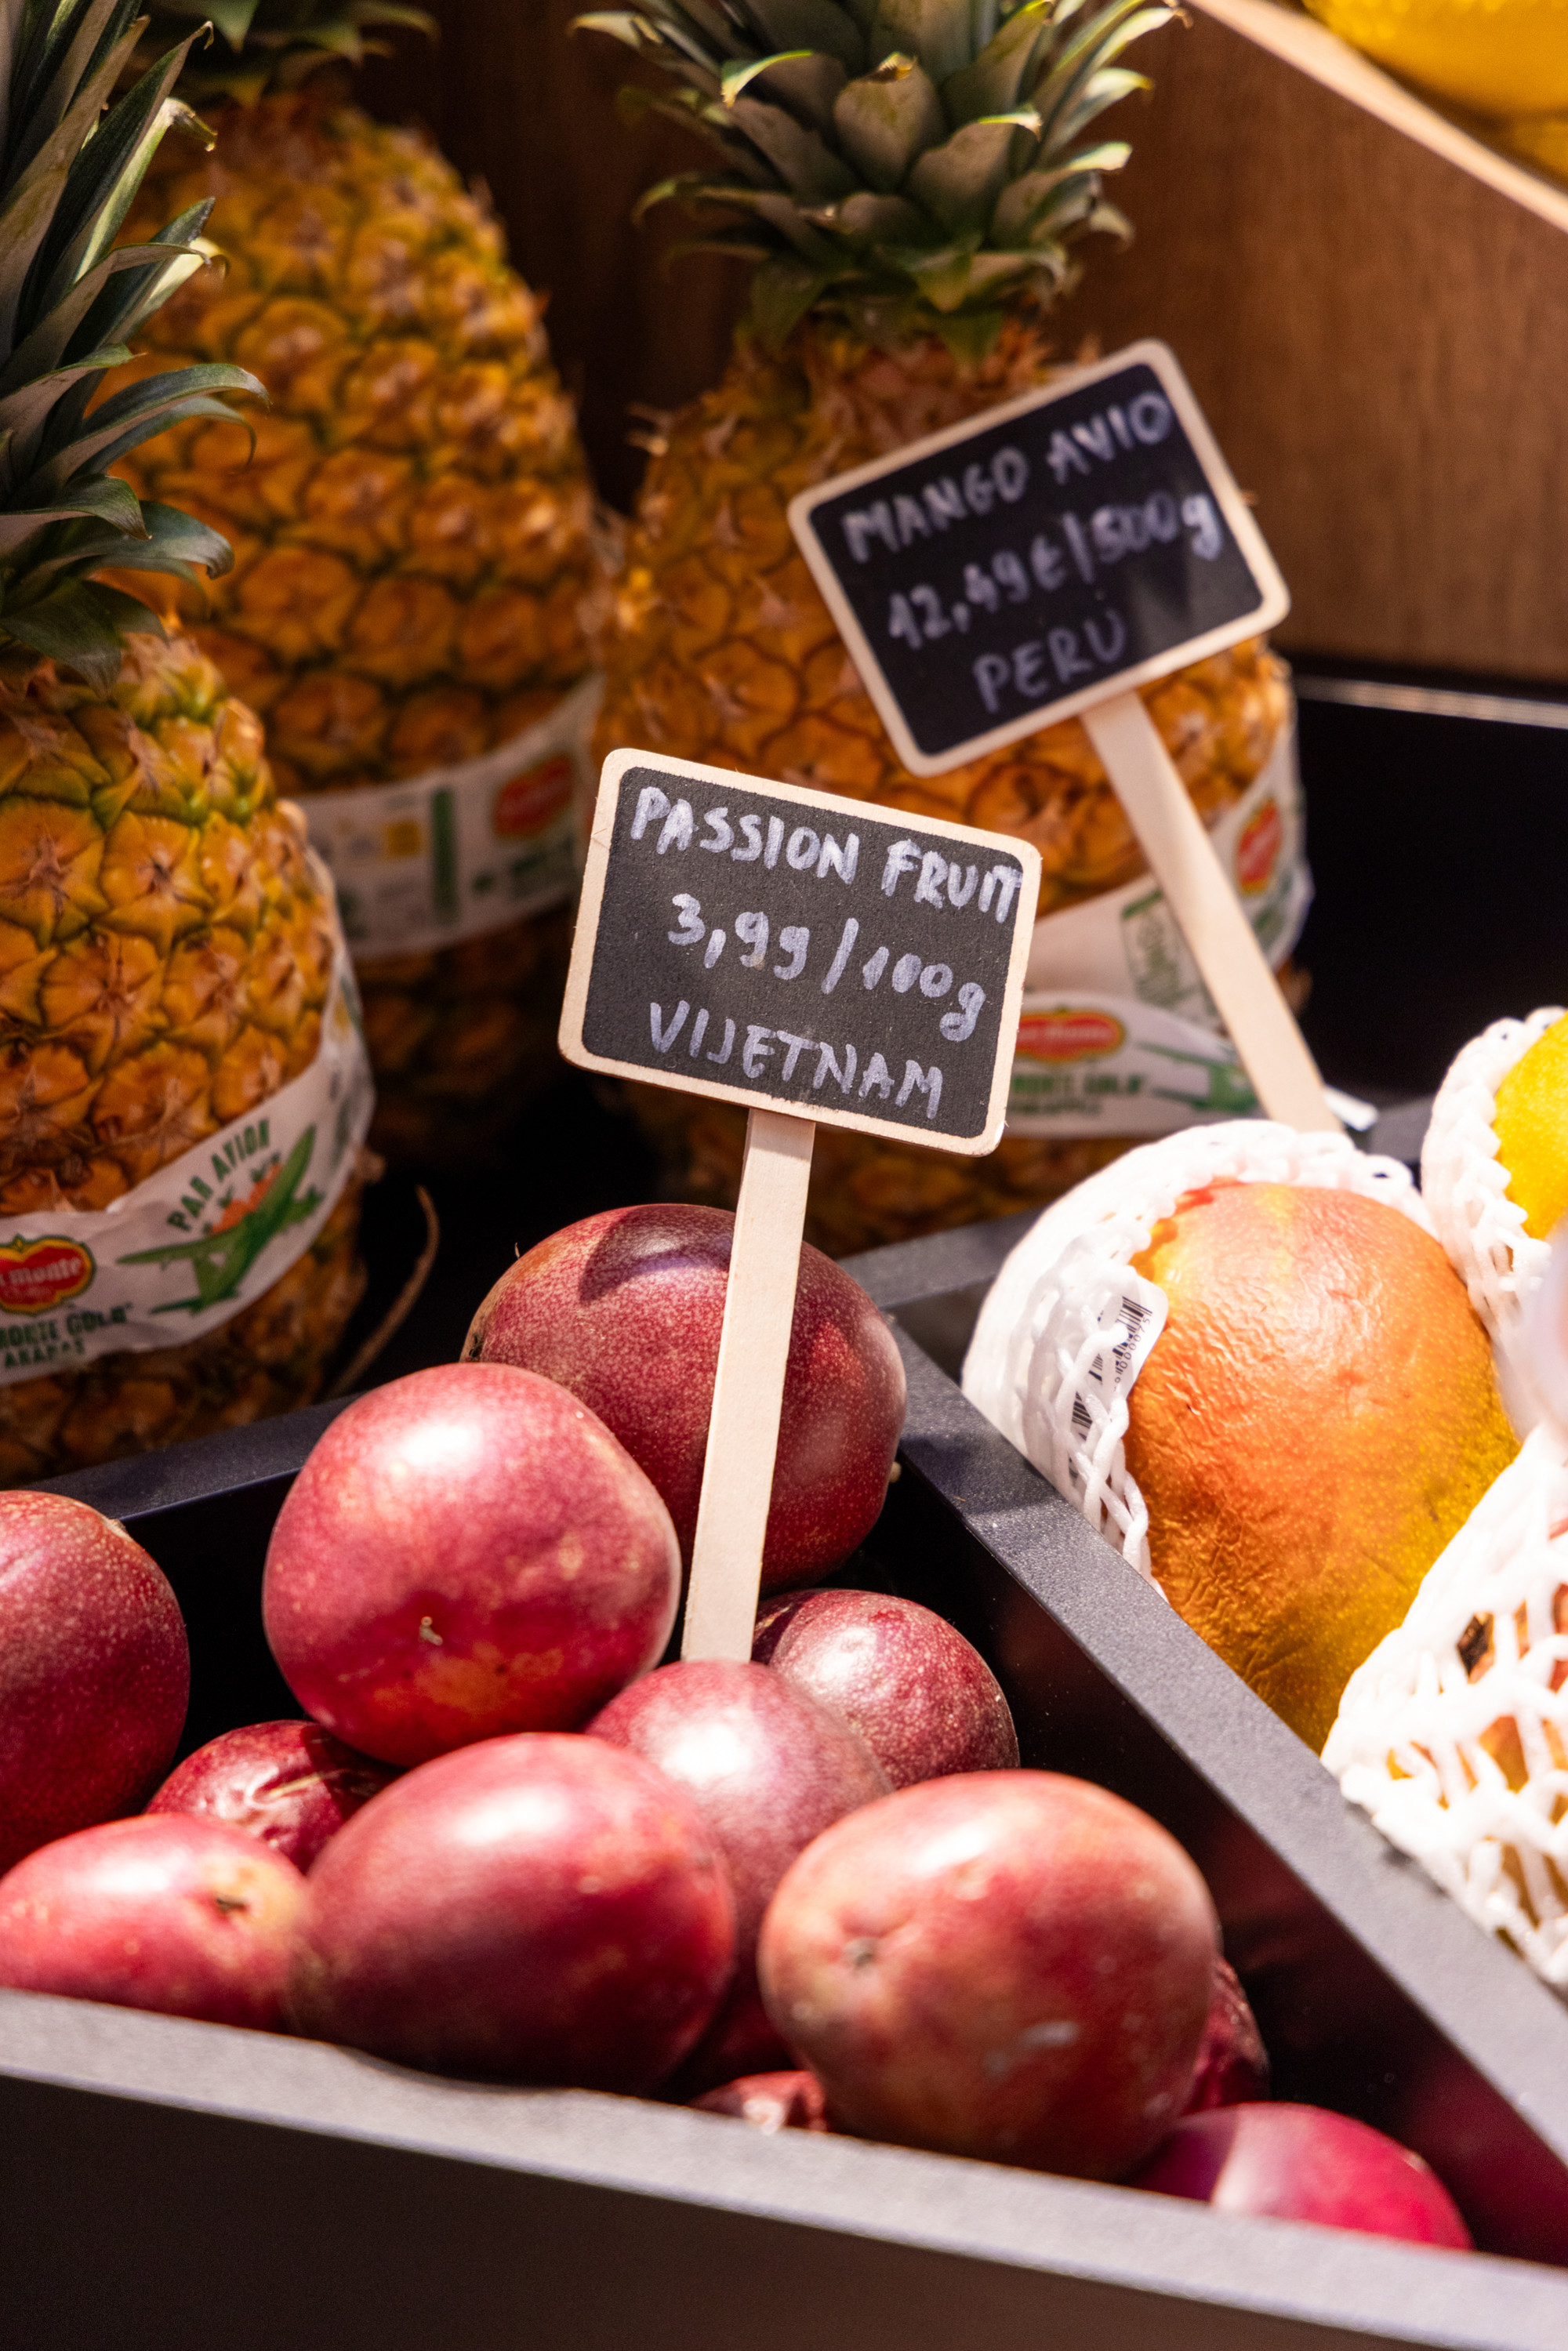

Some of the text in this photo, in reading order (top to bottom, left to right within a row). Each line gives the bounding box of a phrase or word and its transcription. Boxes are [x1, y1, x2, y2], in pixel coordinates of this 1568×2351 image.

[841, 392, 1173, 563] MANGO AVIO
[973, 609, 1126, 713] PERU
[630, 786, 860, 884] PASSION
[881, 838, 1022, 923] FRUIT
[650, 1000, 943, 1120] VIJETNAM
